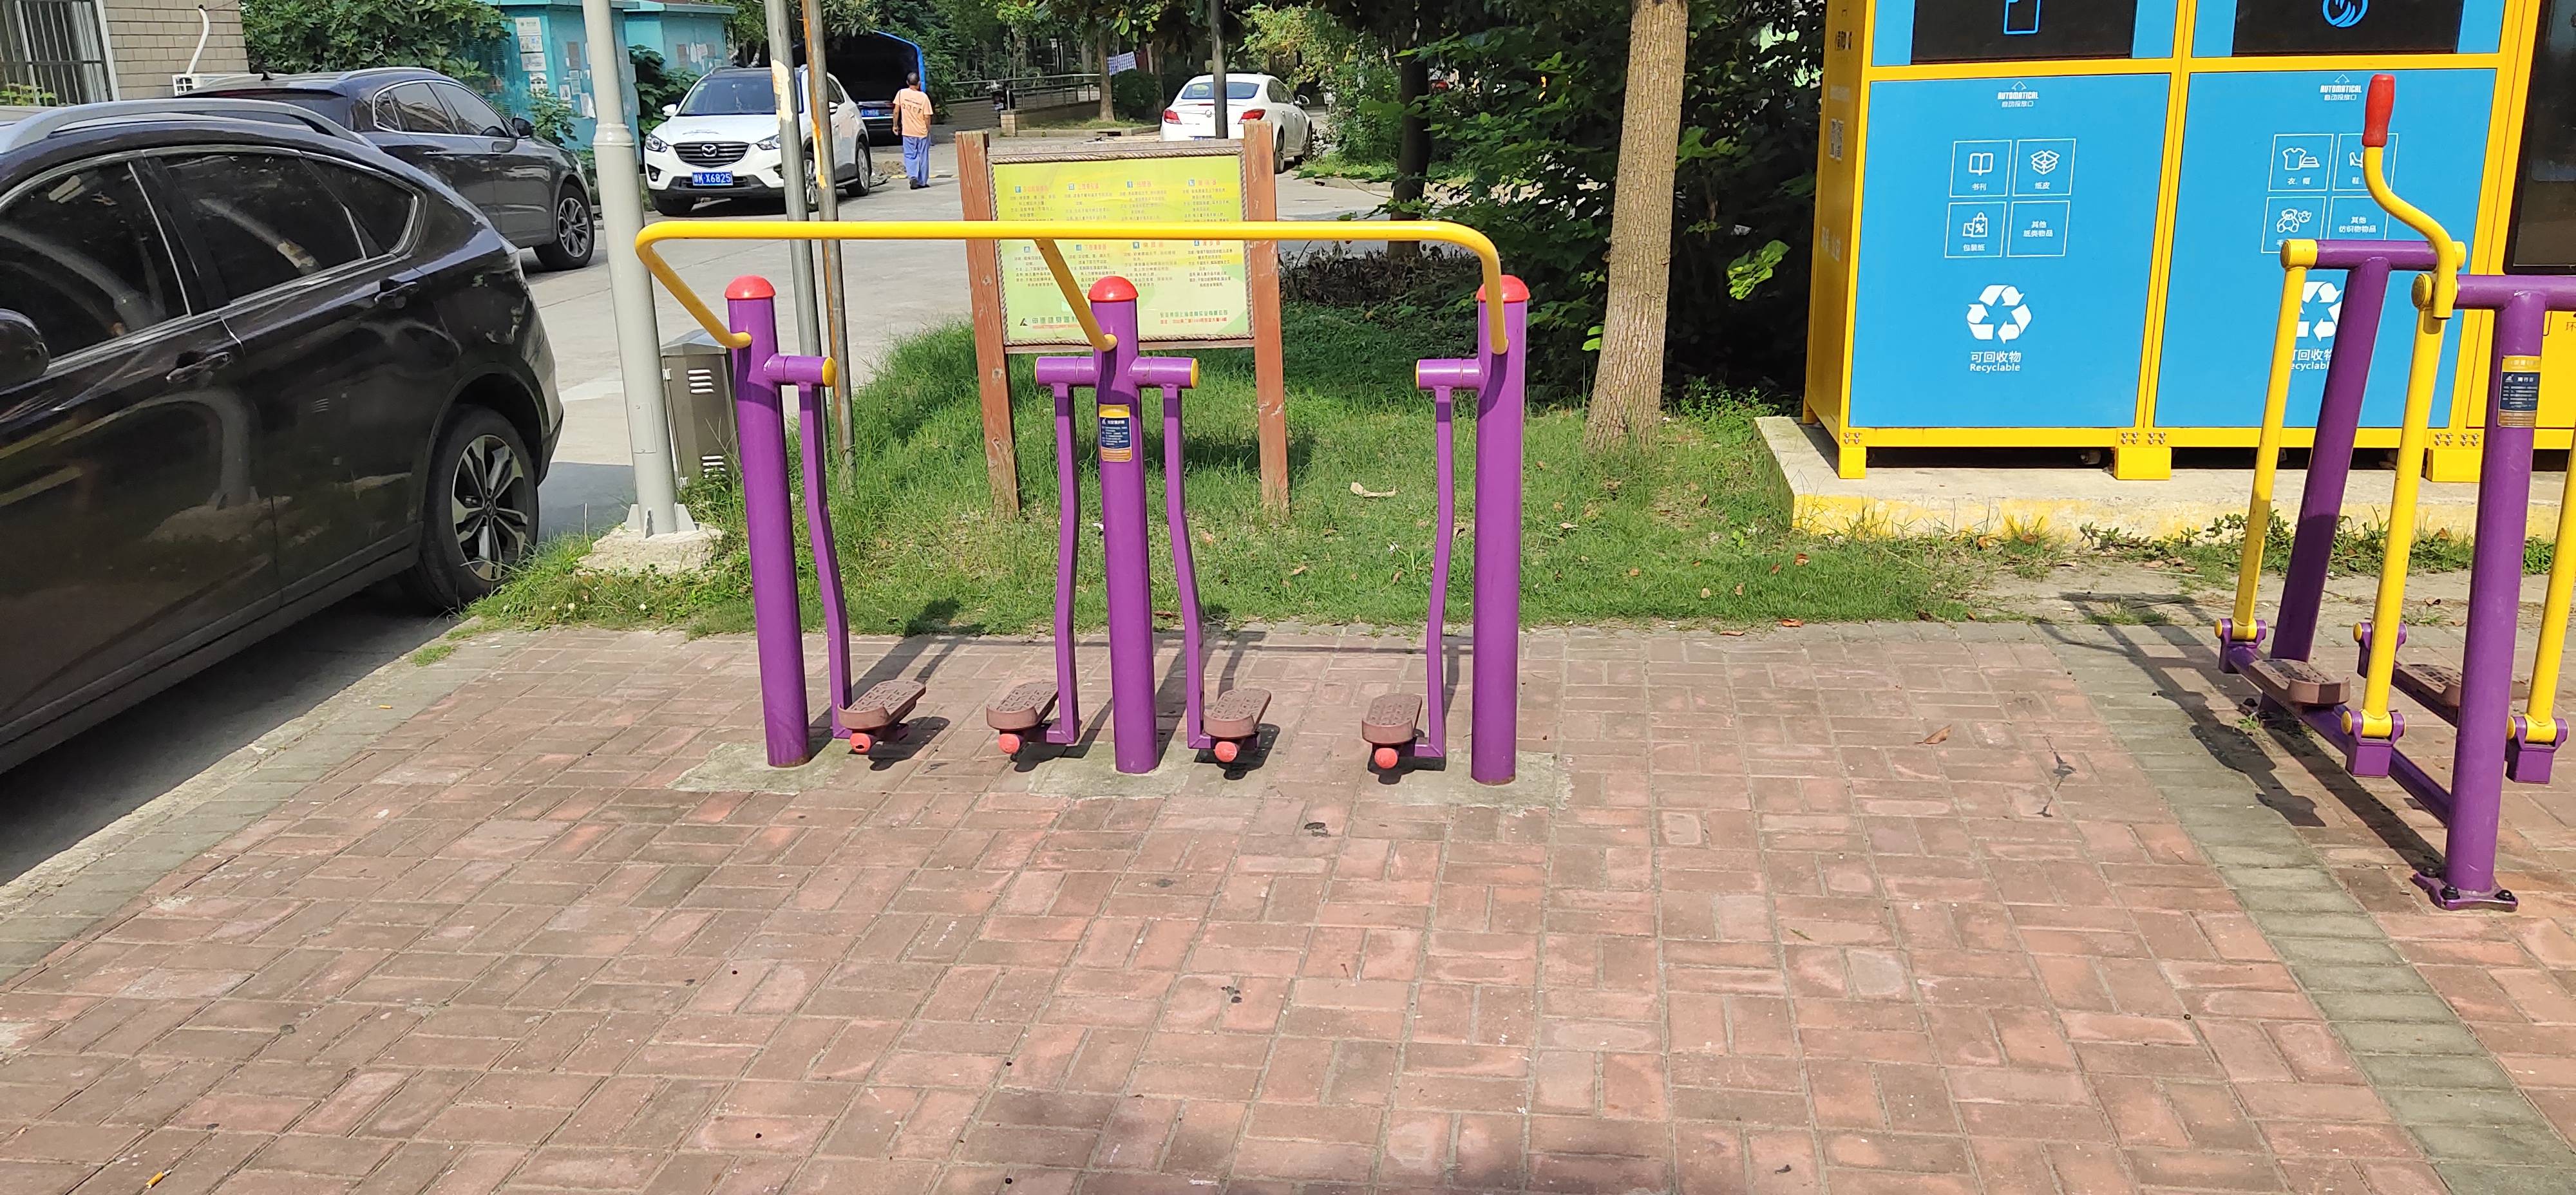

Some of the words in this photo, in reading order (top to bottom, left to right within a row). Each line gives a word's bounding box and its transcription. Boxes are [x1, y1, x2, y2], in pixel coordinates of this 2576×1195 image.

[2034, 182, 2050, 190] 纸皮
[1963, 243, 1985, 252] 包装纸
[1971, 350, 2022, 363] 可回收物
[1970, 363, 2020, 373] Recyclable
[2291, 361, 2329, 372] ecyclabl
